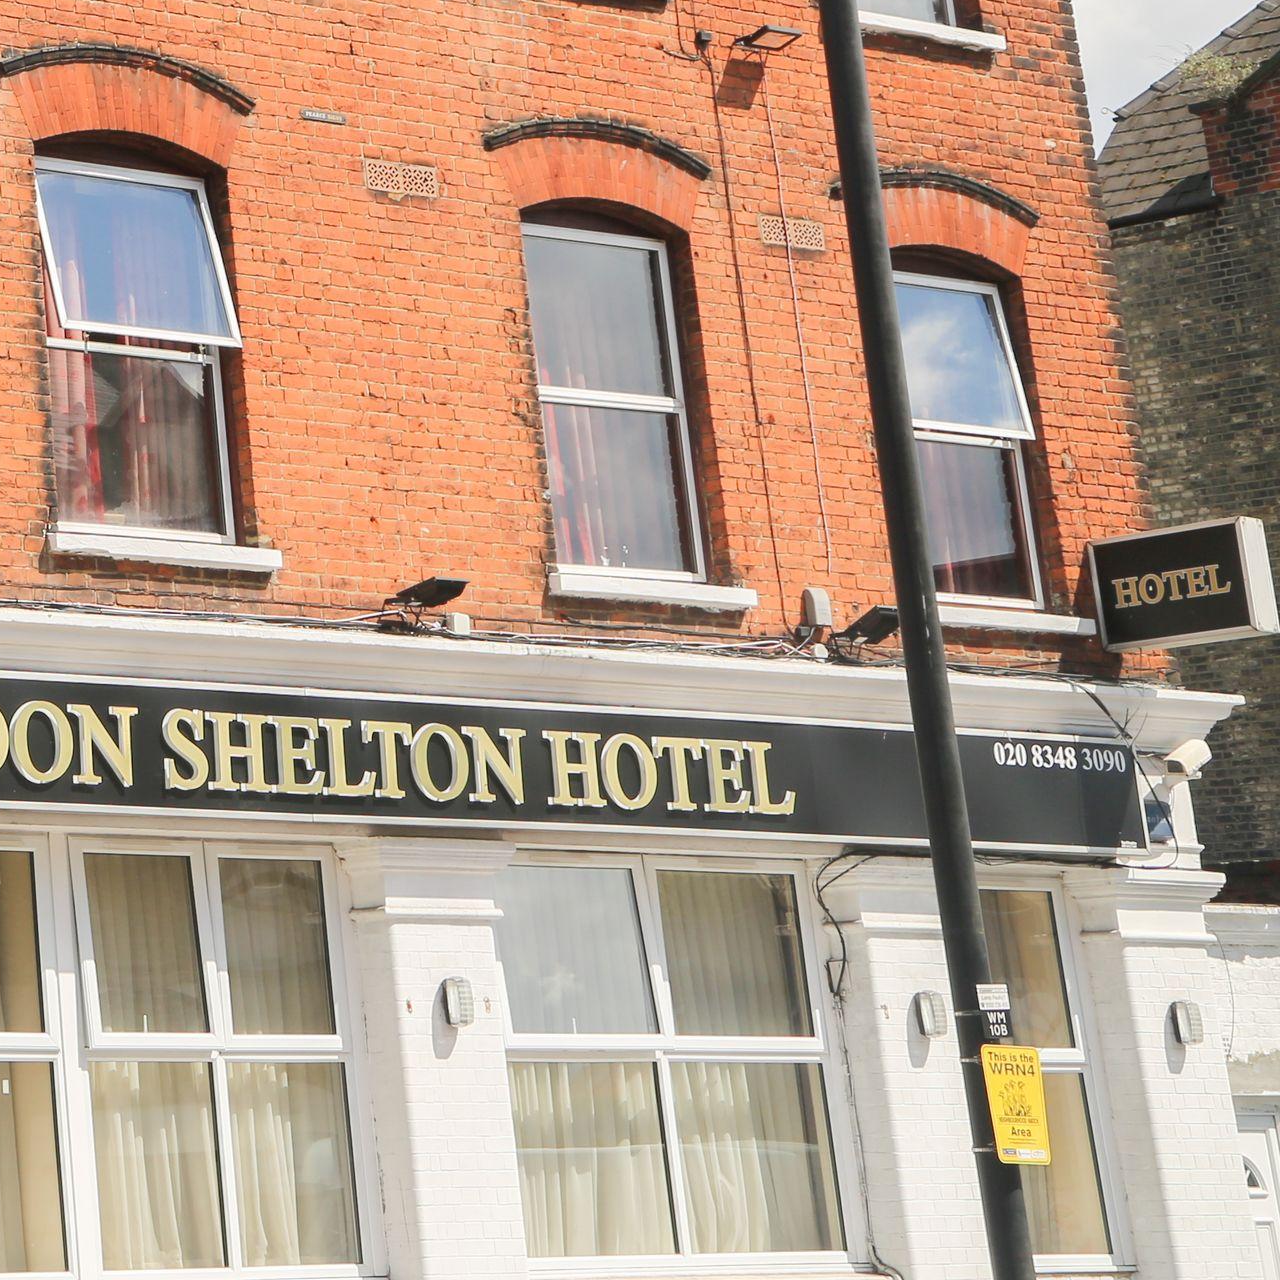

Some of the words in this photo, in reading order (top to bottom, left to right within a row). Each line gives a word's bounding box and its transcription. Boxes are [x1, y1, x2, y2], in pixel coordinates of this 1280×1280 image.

[1111, 563, 1232, 609] HOTEL
[161, 707, 528, 806] SHELTON
[541, 729, 797, 816] HOTEL
[993, 741, 1028, 767] 020
[1030, 744, 1078, 770] 8348
[1081, 747, 1126, 773] 3090
[986, 1011, 1007, 1023] WM
[989, 1024, 1008, 1036] 10B
[987, 1051, 1007, 1062] This
[1009, 1053, 1018, 1062] is
[1019, 1052, 1034, 1063] the
[989, 1062, 1035, 1077] WRN4
[1011, 1126, 1032, 1137] Area
